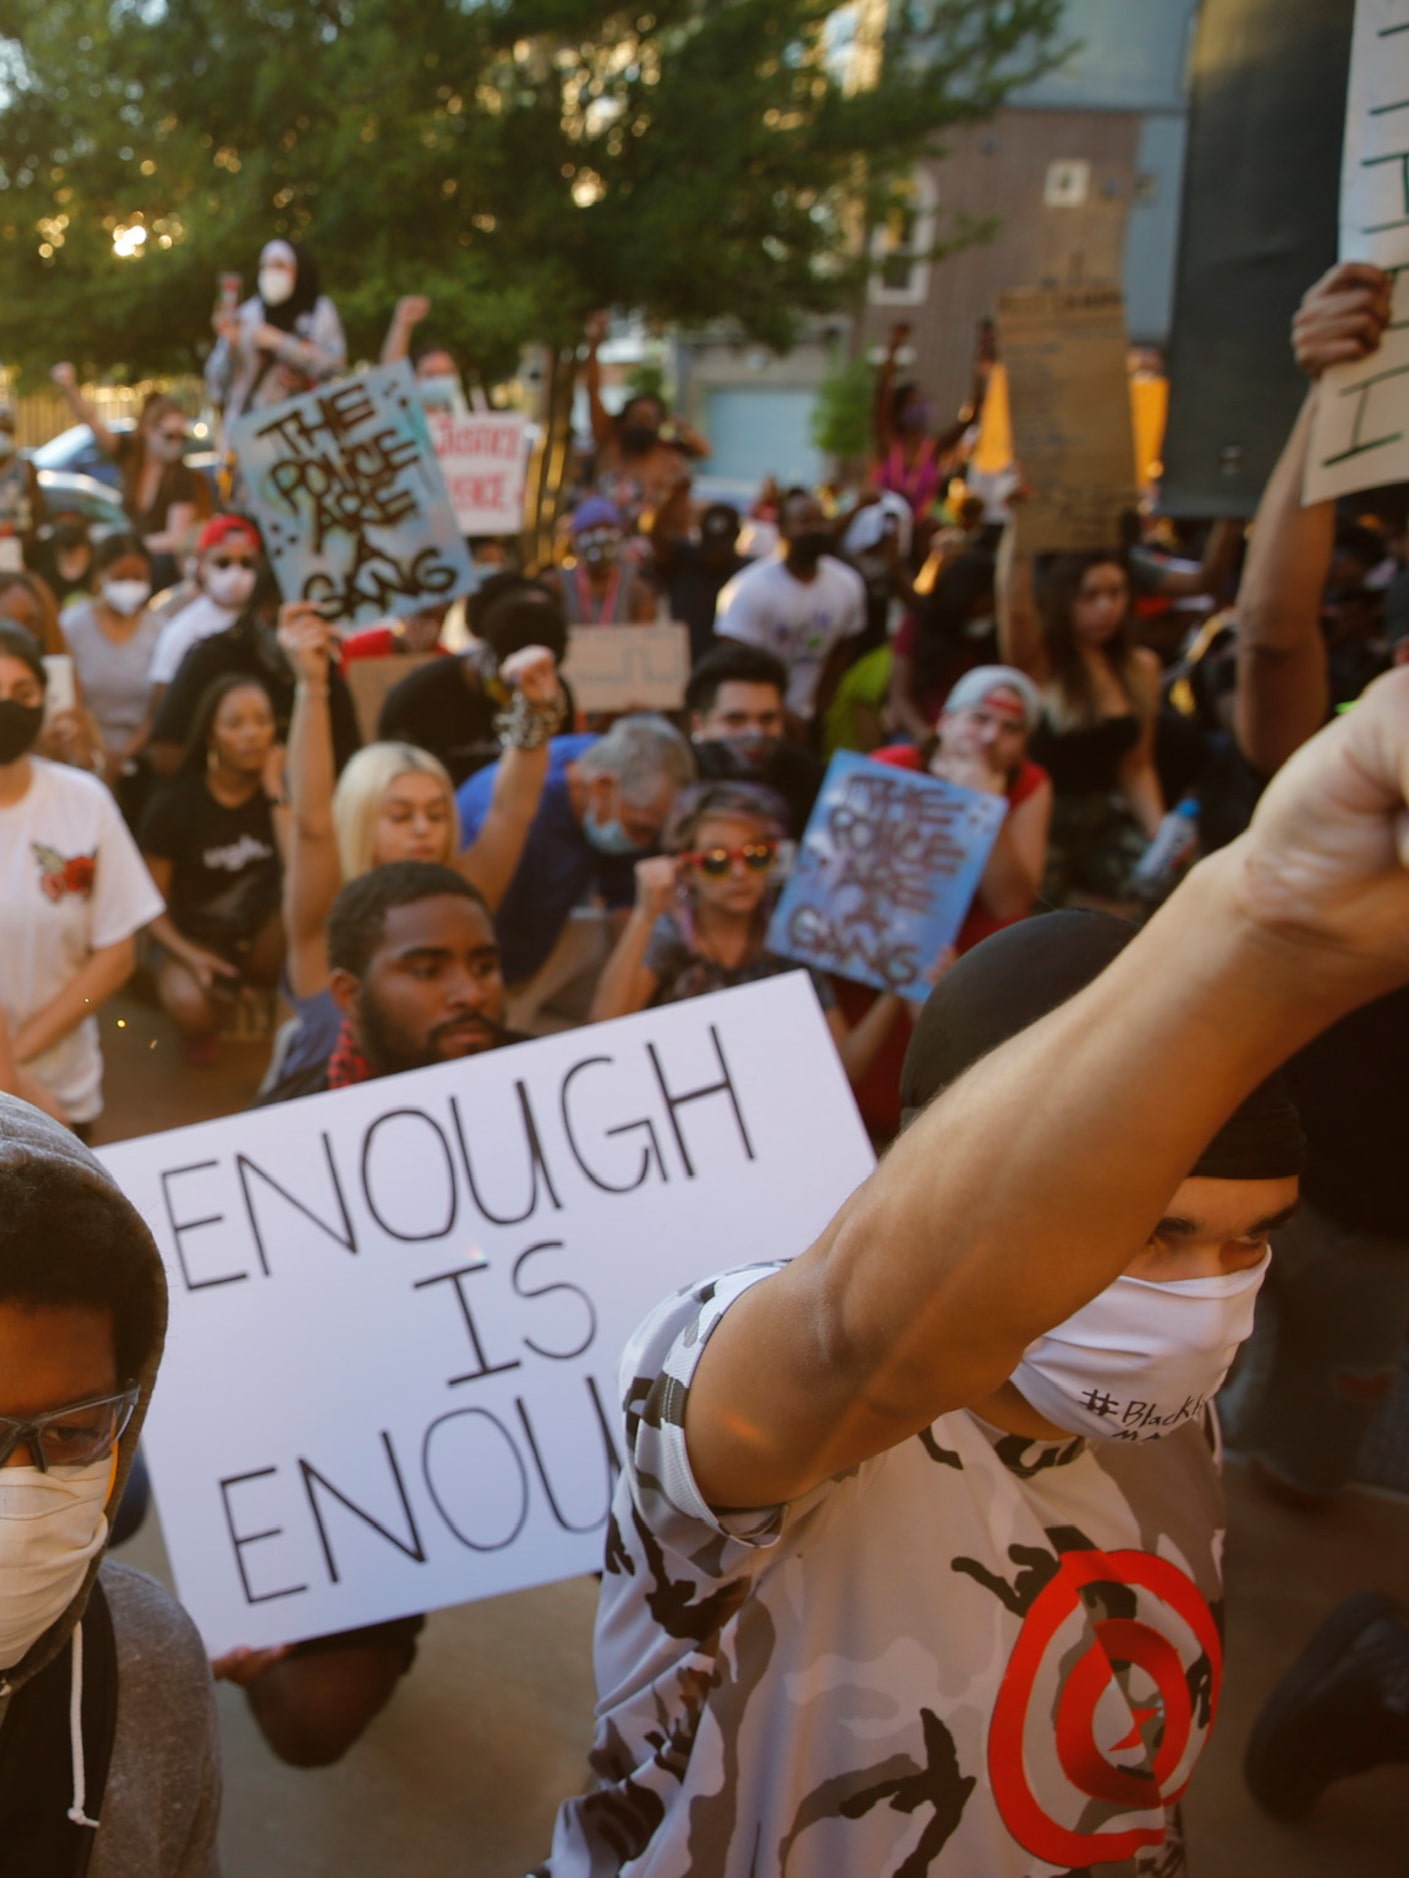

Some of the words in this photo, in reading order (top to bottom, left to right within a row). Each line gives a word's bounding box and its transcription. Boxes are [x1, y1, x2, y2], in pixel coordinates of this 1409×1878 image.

[256, 382, 377, 456] THE
[269, 428, 421, 515] POLICE
[302, 545, 459, 622] GANG
[828, 806, 969, 876] POLICE
[847, 774, 967, 828] THE
[160, 1023, 756, 1293] ENOUGH
[412, 1240, 596, 1389] IS
[218, 1375, 622, 1604] ENOU
